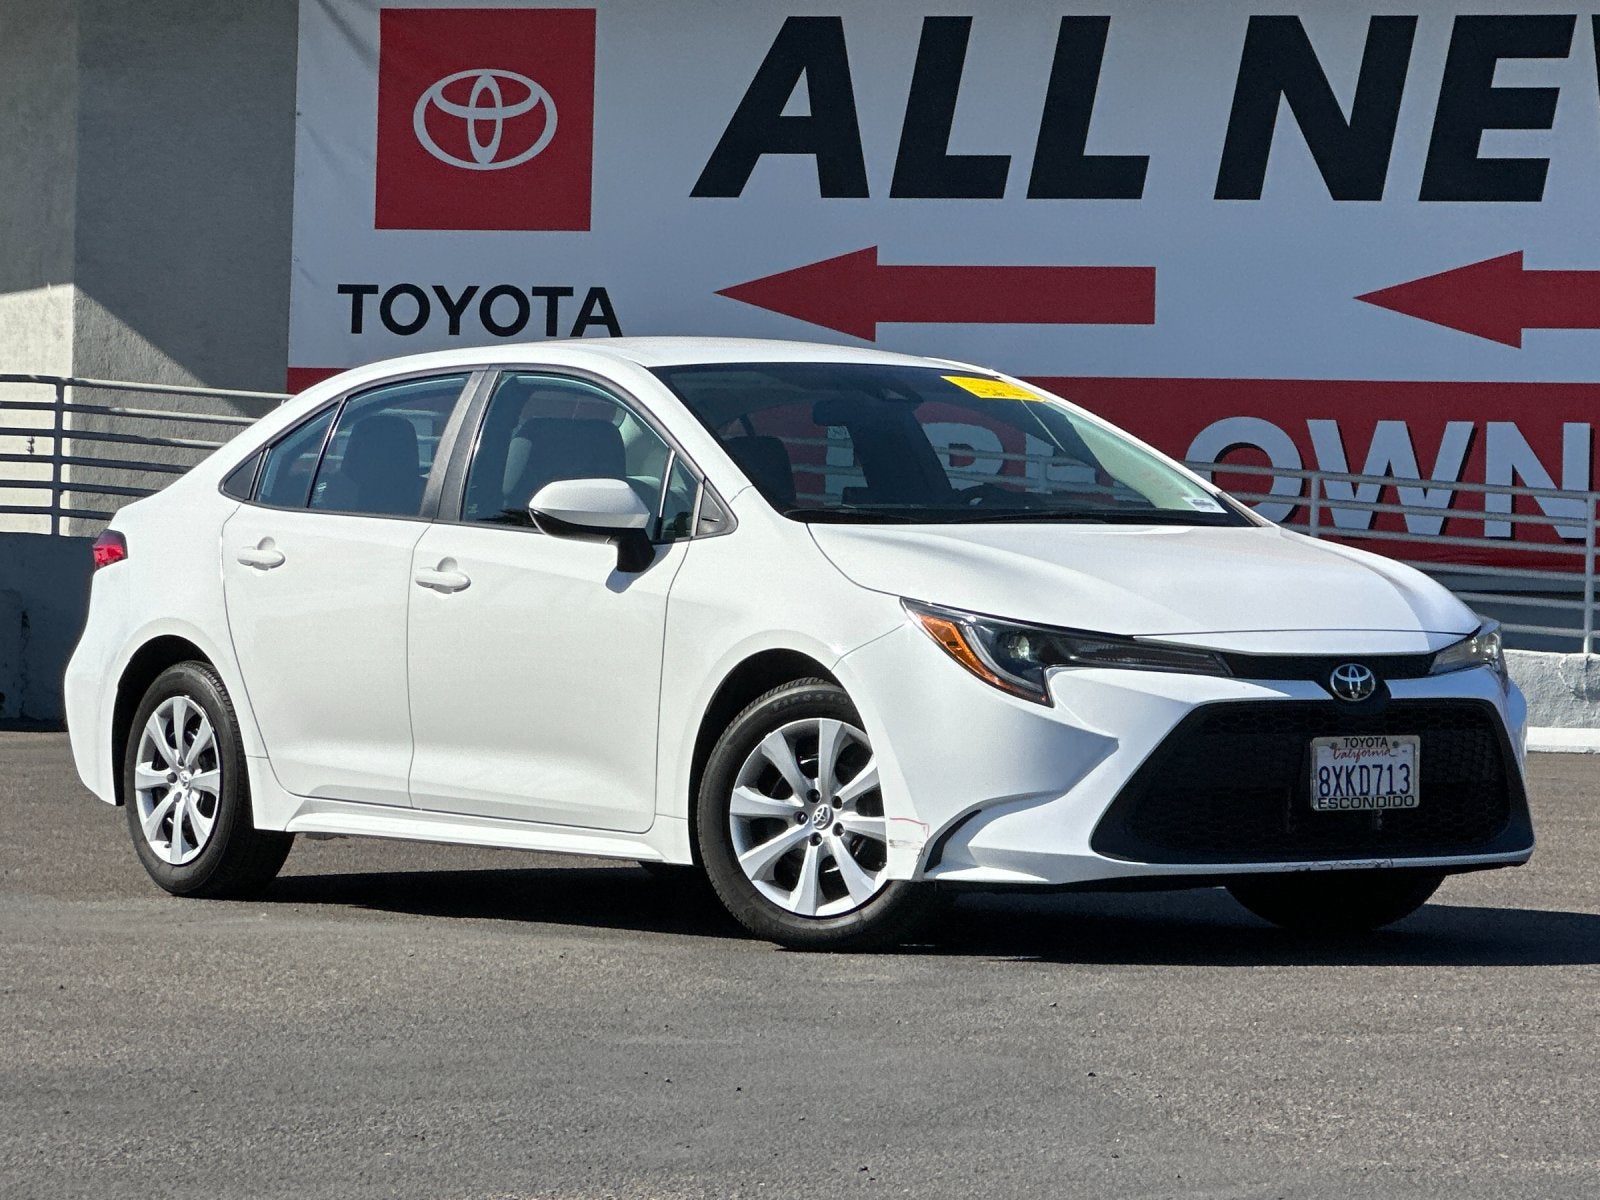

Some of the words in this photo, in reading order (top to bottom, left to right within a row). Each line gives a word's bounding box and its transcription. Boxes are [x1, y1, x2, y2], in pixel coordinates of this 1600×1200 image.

[689, 15, 1151, 199] ALL
[1213, 14, 1600, 202] NE
[337, 282, 623, 338] TOYOTA
[1343, 736, 1388, 748] TOYOTA
[1333, 747, 1399, 763] California
[1319, 763, 1411, 796] 8XKD713
[1317, 795, 1415, 809] ESCONDIDO
